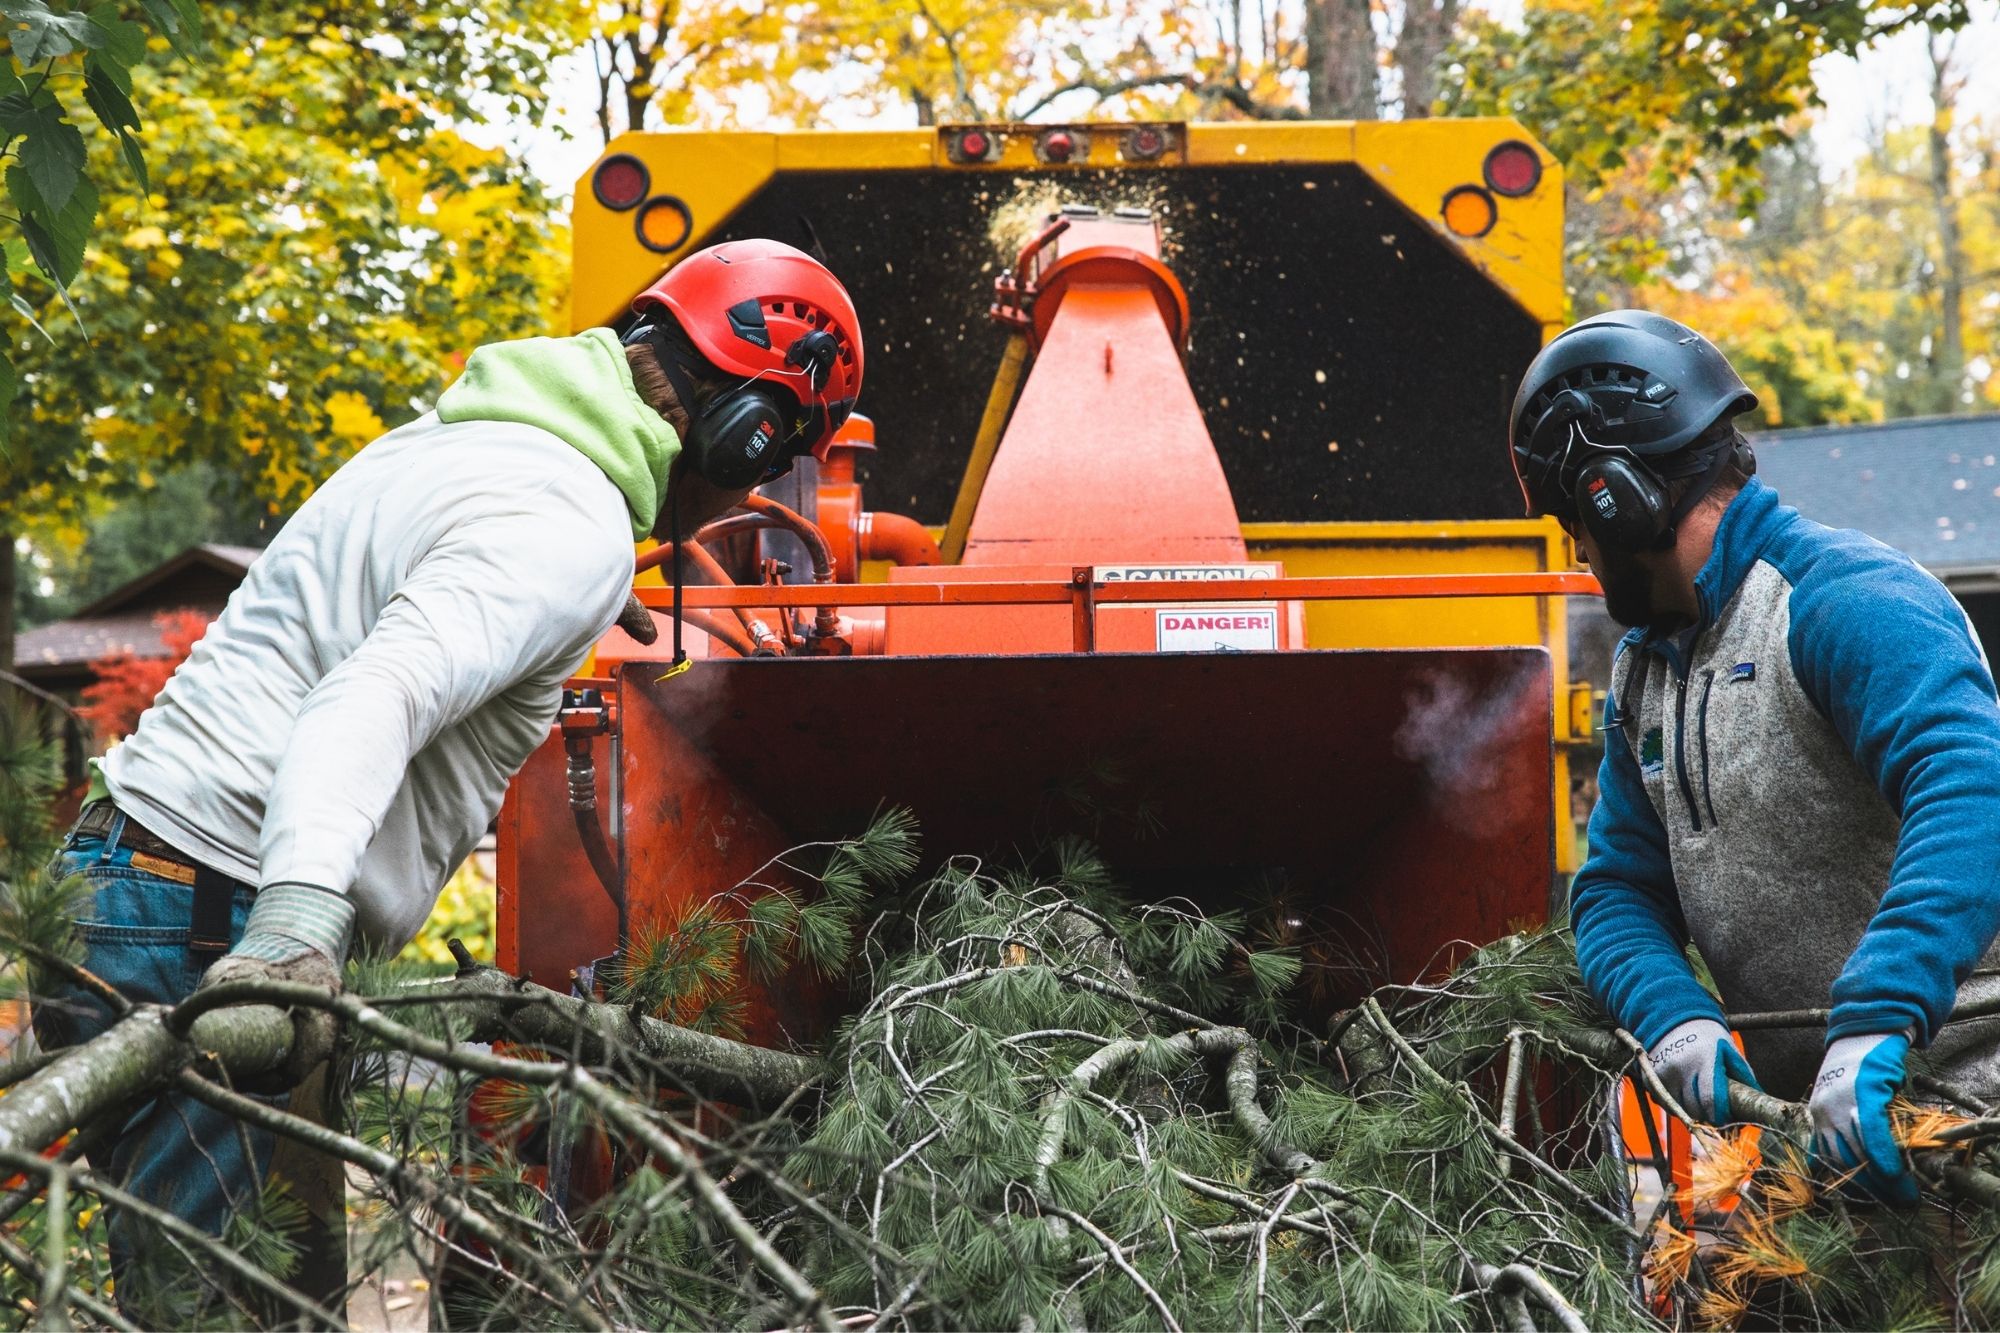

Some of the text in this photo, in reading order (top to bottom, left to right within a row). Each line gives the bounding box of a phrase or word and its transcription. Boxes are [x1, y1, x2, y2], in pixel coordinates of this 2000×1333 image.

[760, 420, 776, 438] 3M
[751, 436, 765, 452] 101
[1588, 478, 1606, 494] 3M
[1597, 495, 1613, 510] 101
[1165, 617, 1270, 631] DANGER!
